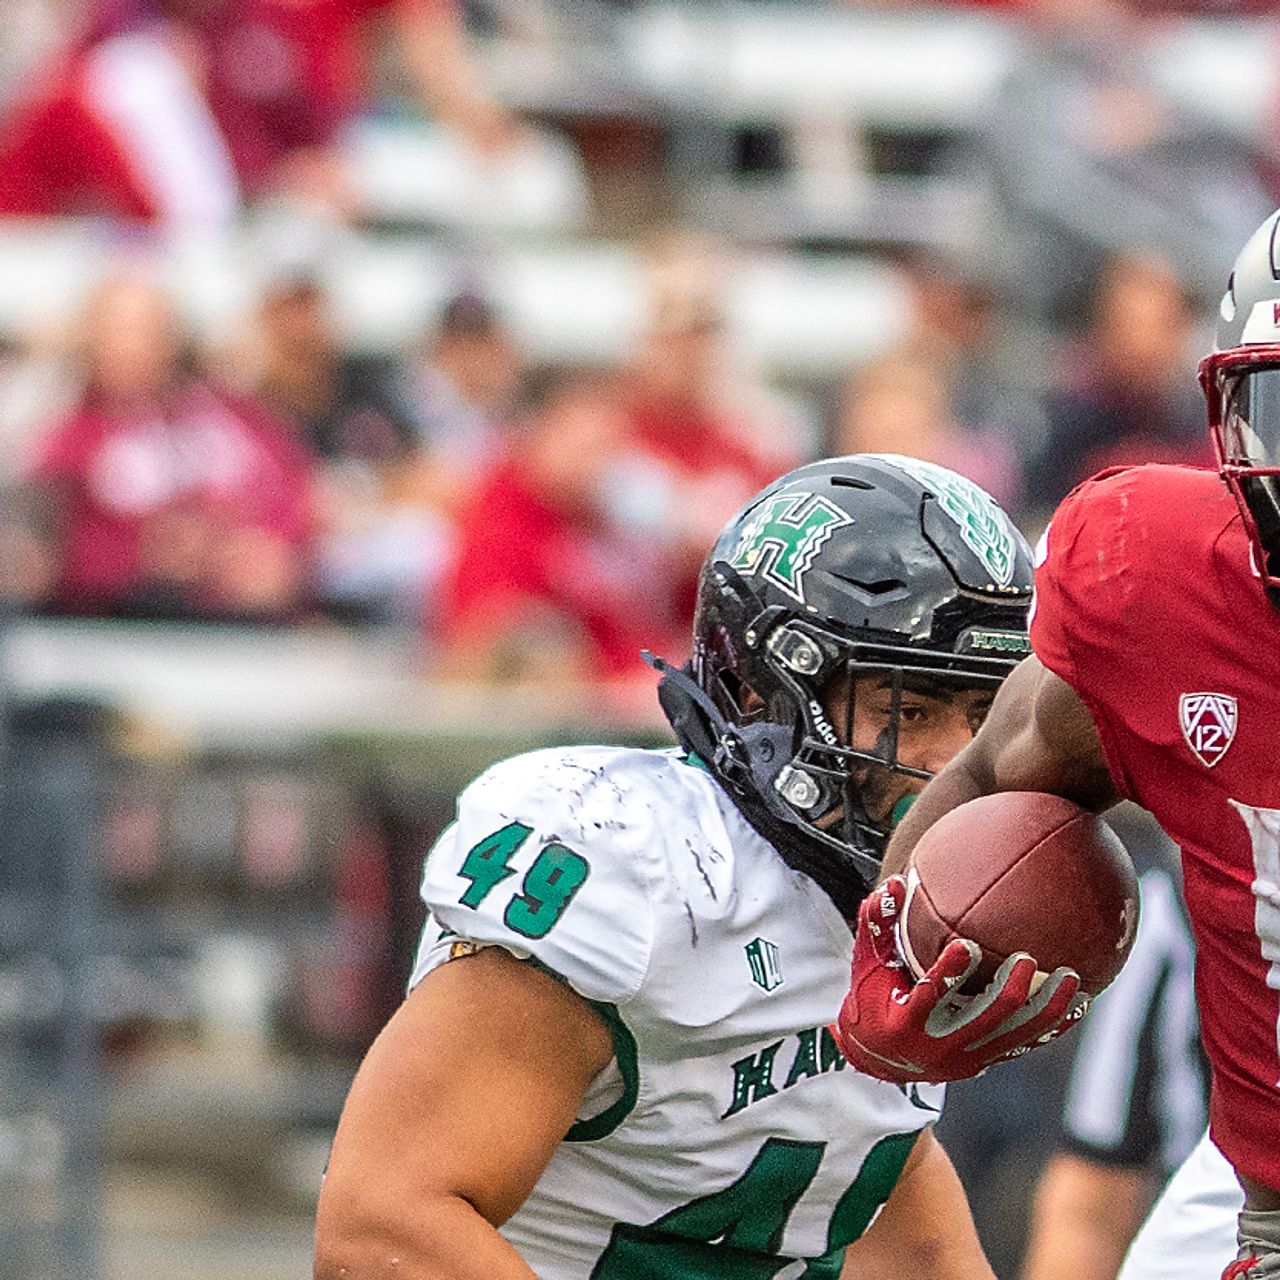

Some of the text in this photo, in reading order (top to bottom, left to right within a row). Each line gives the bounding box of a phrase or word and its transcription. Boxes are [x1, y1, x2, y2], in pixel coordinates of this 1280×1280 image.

[1183, 695, 1235, 739] PAC
[1196, 724, 1224, 752] 12
[456, 820, 592, 940] 49
